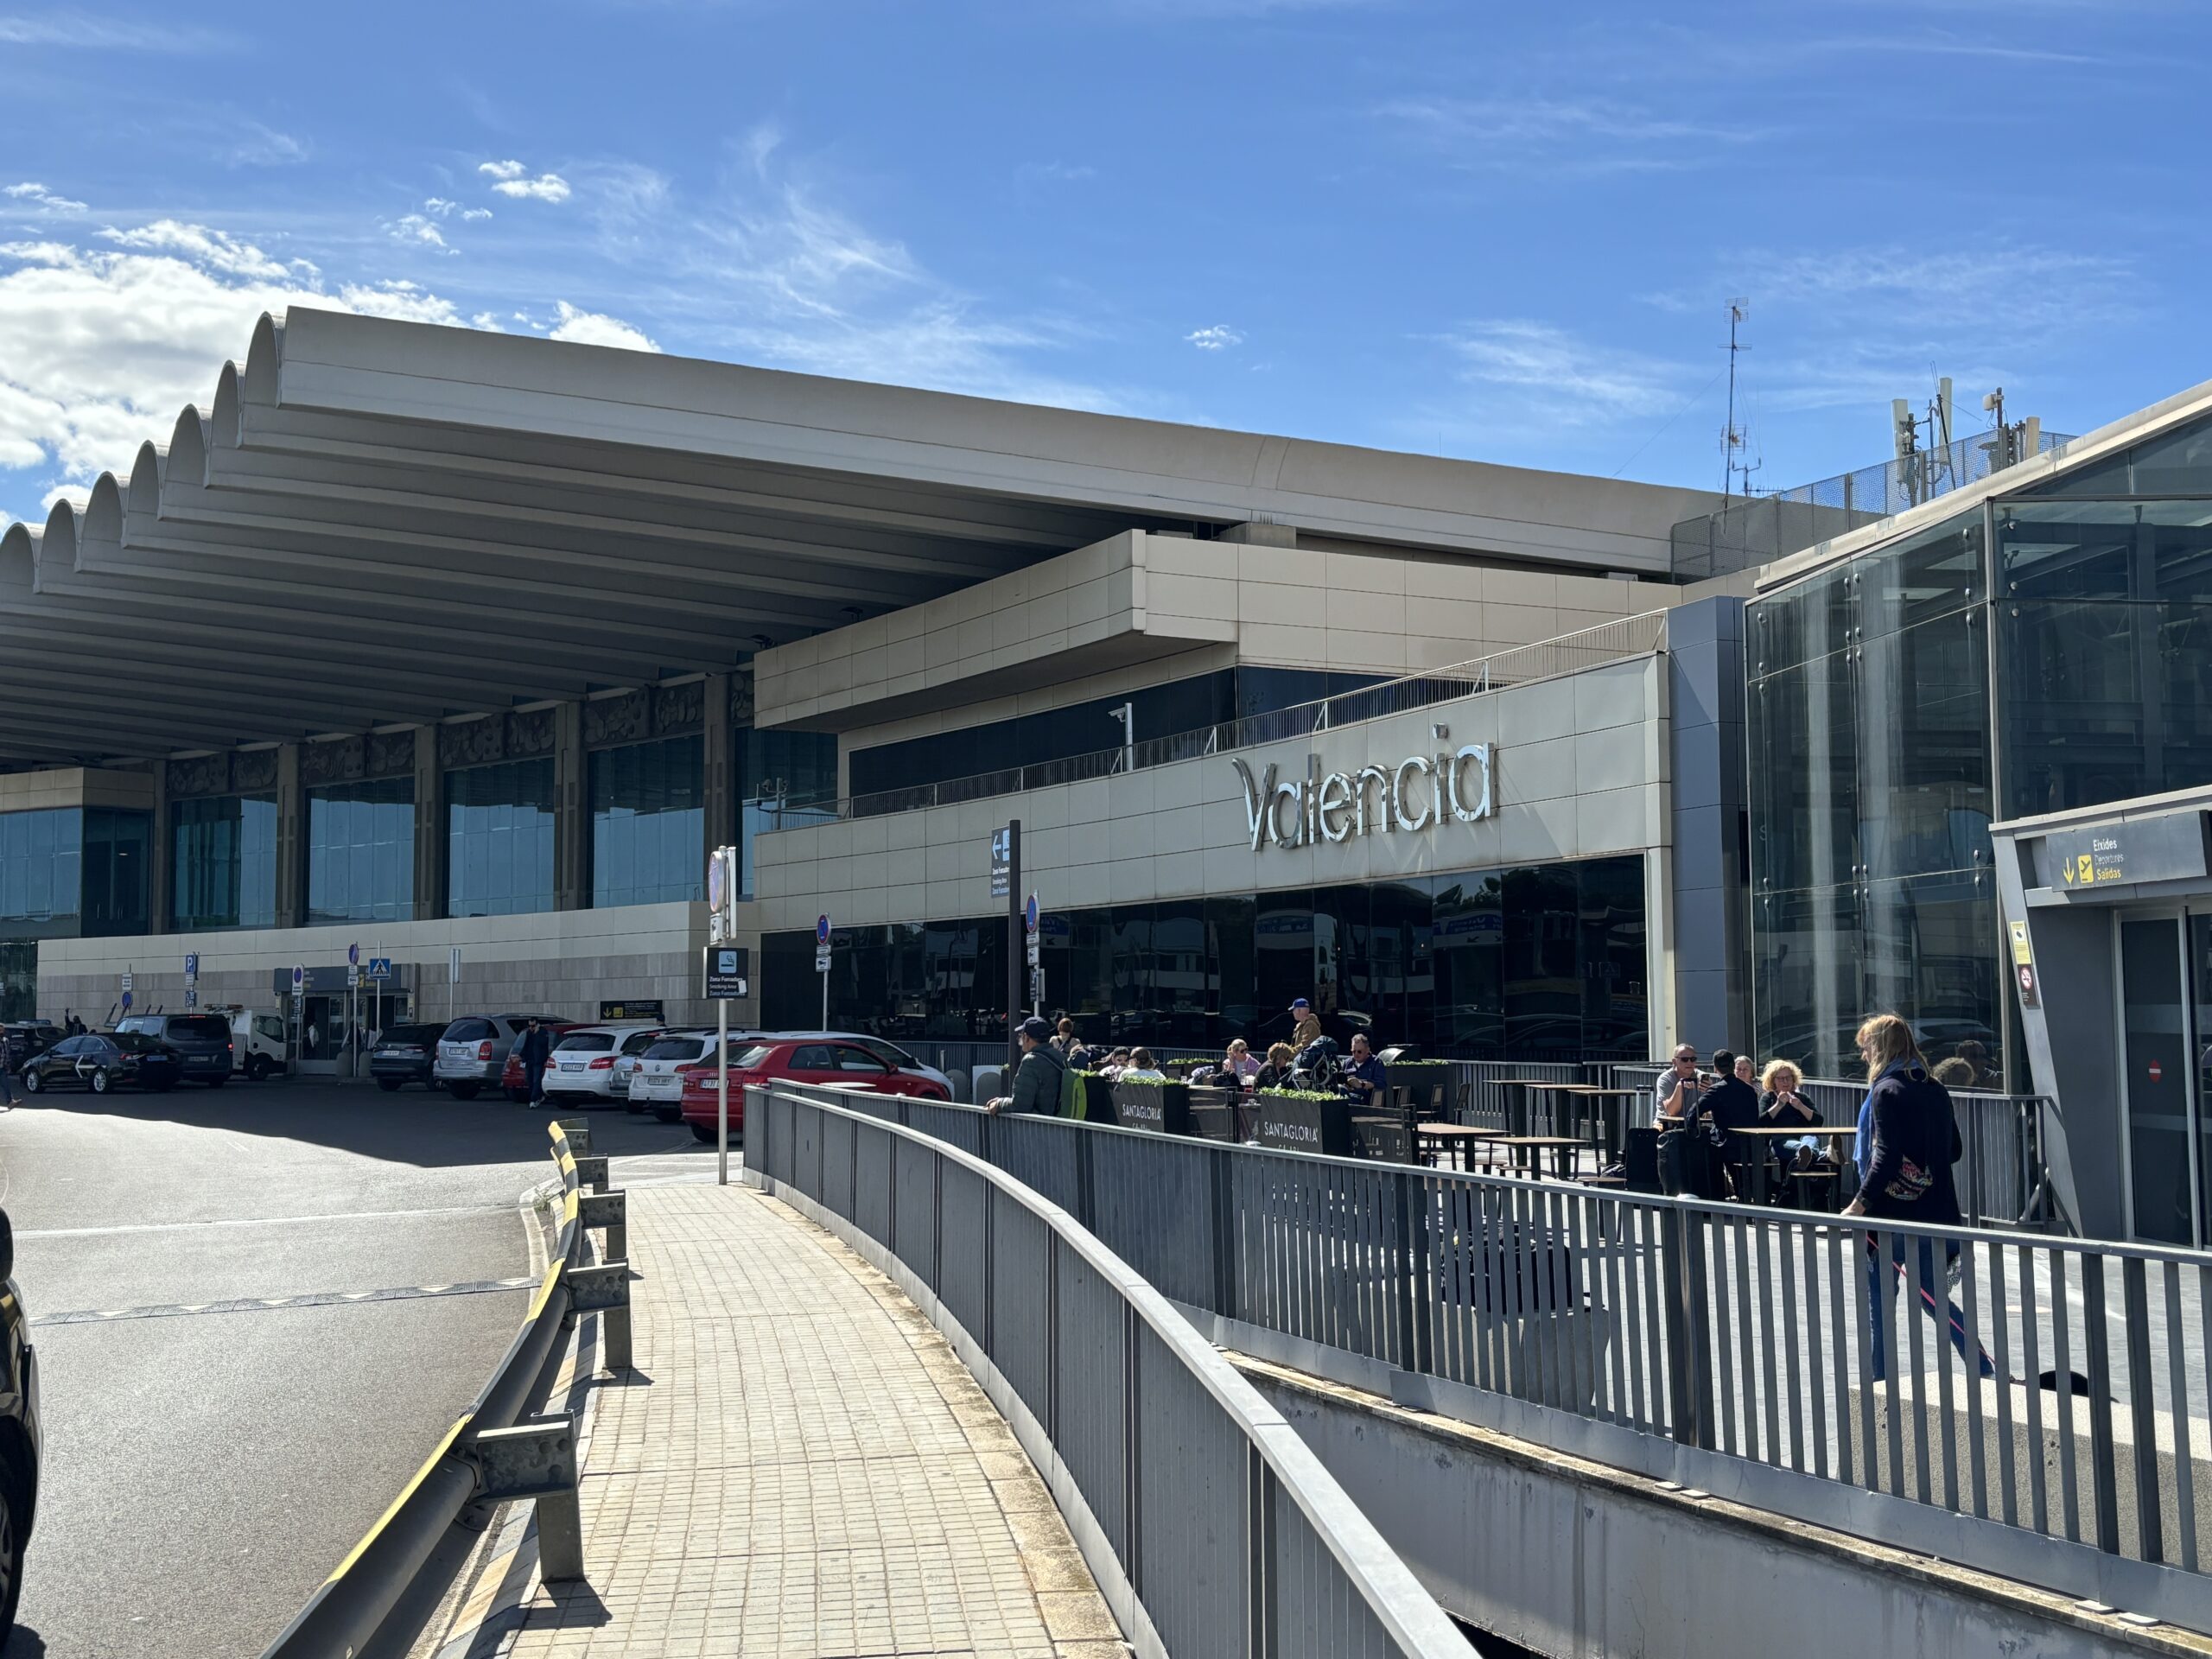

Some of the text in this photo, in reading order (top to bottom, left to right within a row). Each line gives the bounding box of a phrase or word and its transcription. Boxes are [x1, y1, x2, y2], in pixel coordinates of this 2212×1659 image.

[1231, 722, 1495, 851] Valencia
[2093, 838, 2118, 852] Eixides
[2096, 868, 2121, 880] Salidas
[187, 957, 194, 970] P
[1122, 1103, 1161, 1121] SANTAGLORIA
[1264, 1121, 1318, 1143] SANTAGLORIA
